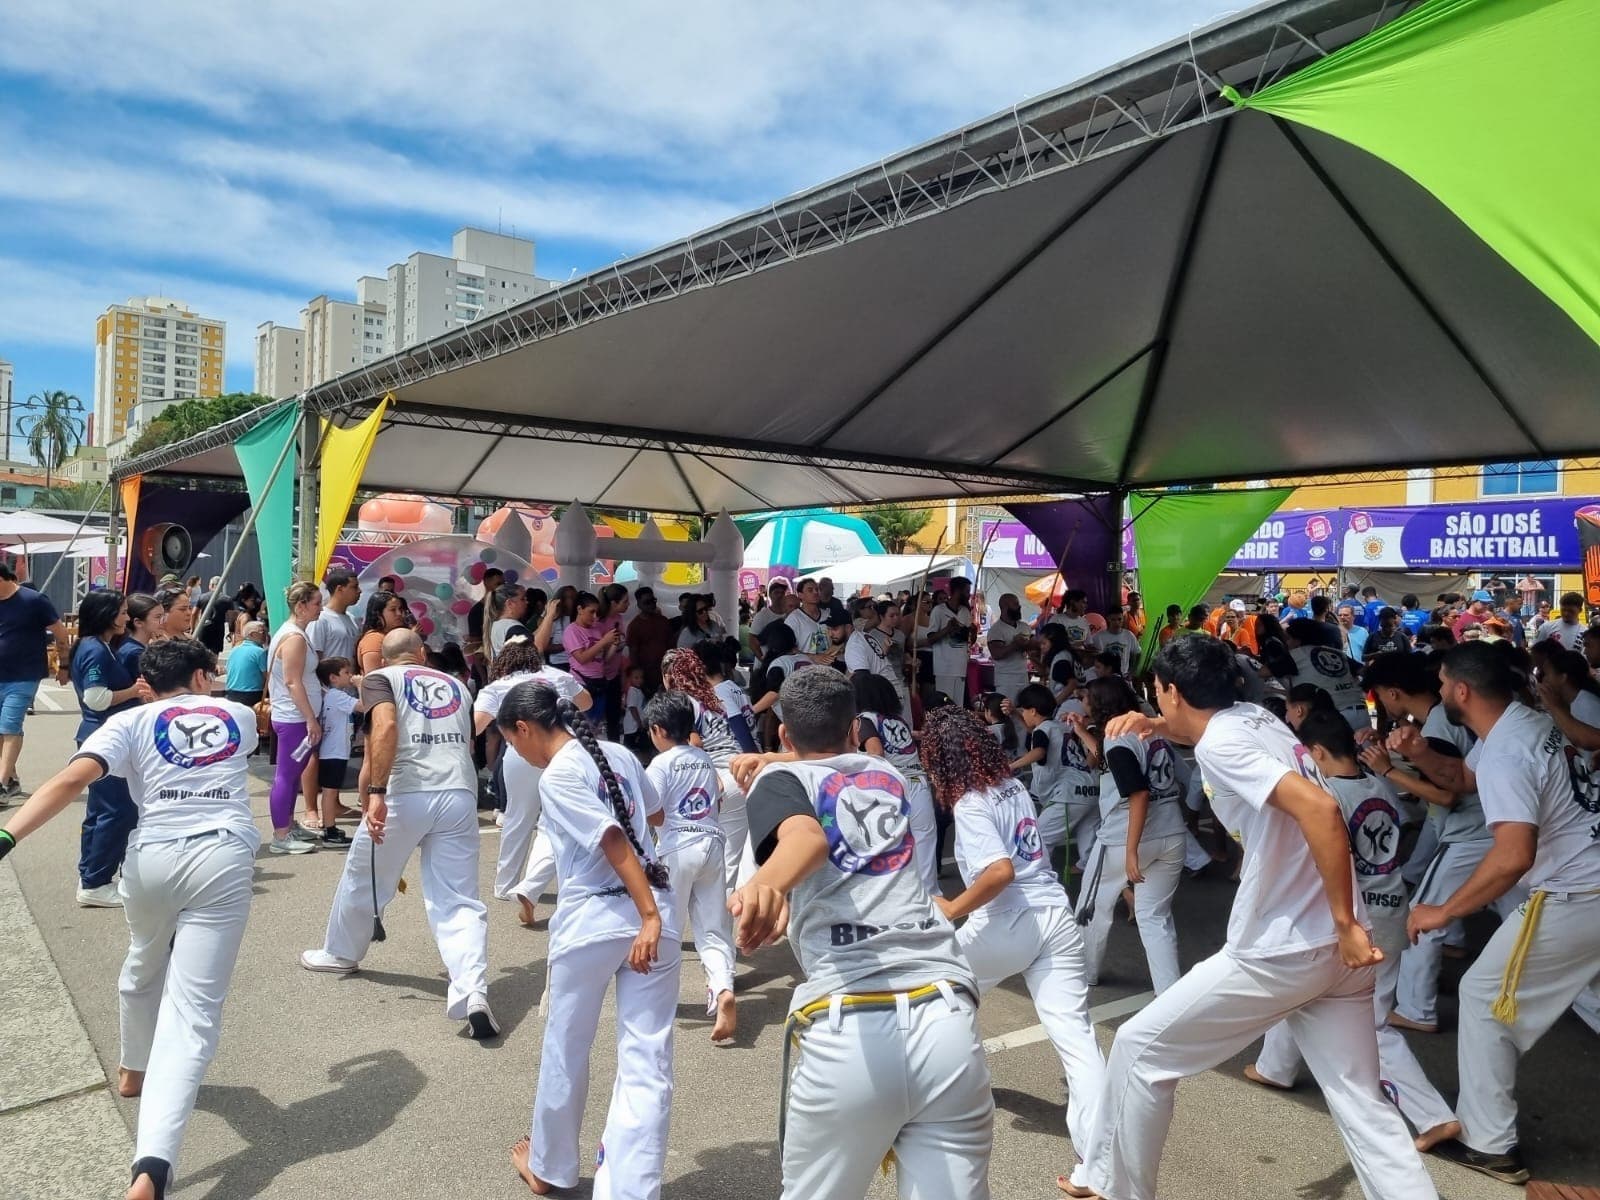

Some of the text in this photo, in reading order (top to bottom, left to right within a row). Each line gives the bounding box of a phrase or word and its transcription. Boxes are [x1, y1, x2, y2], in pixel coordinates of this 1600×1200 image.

[1446, 508, 1541, 535] SÃO JOSÉ
[1234, 541, 1279, 559] ERDE
[1430, 535, 1560, 558] BASKETBALL
[164, 744, 194, 768] TEM
